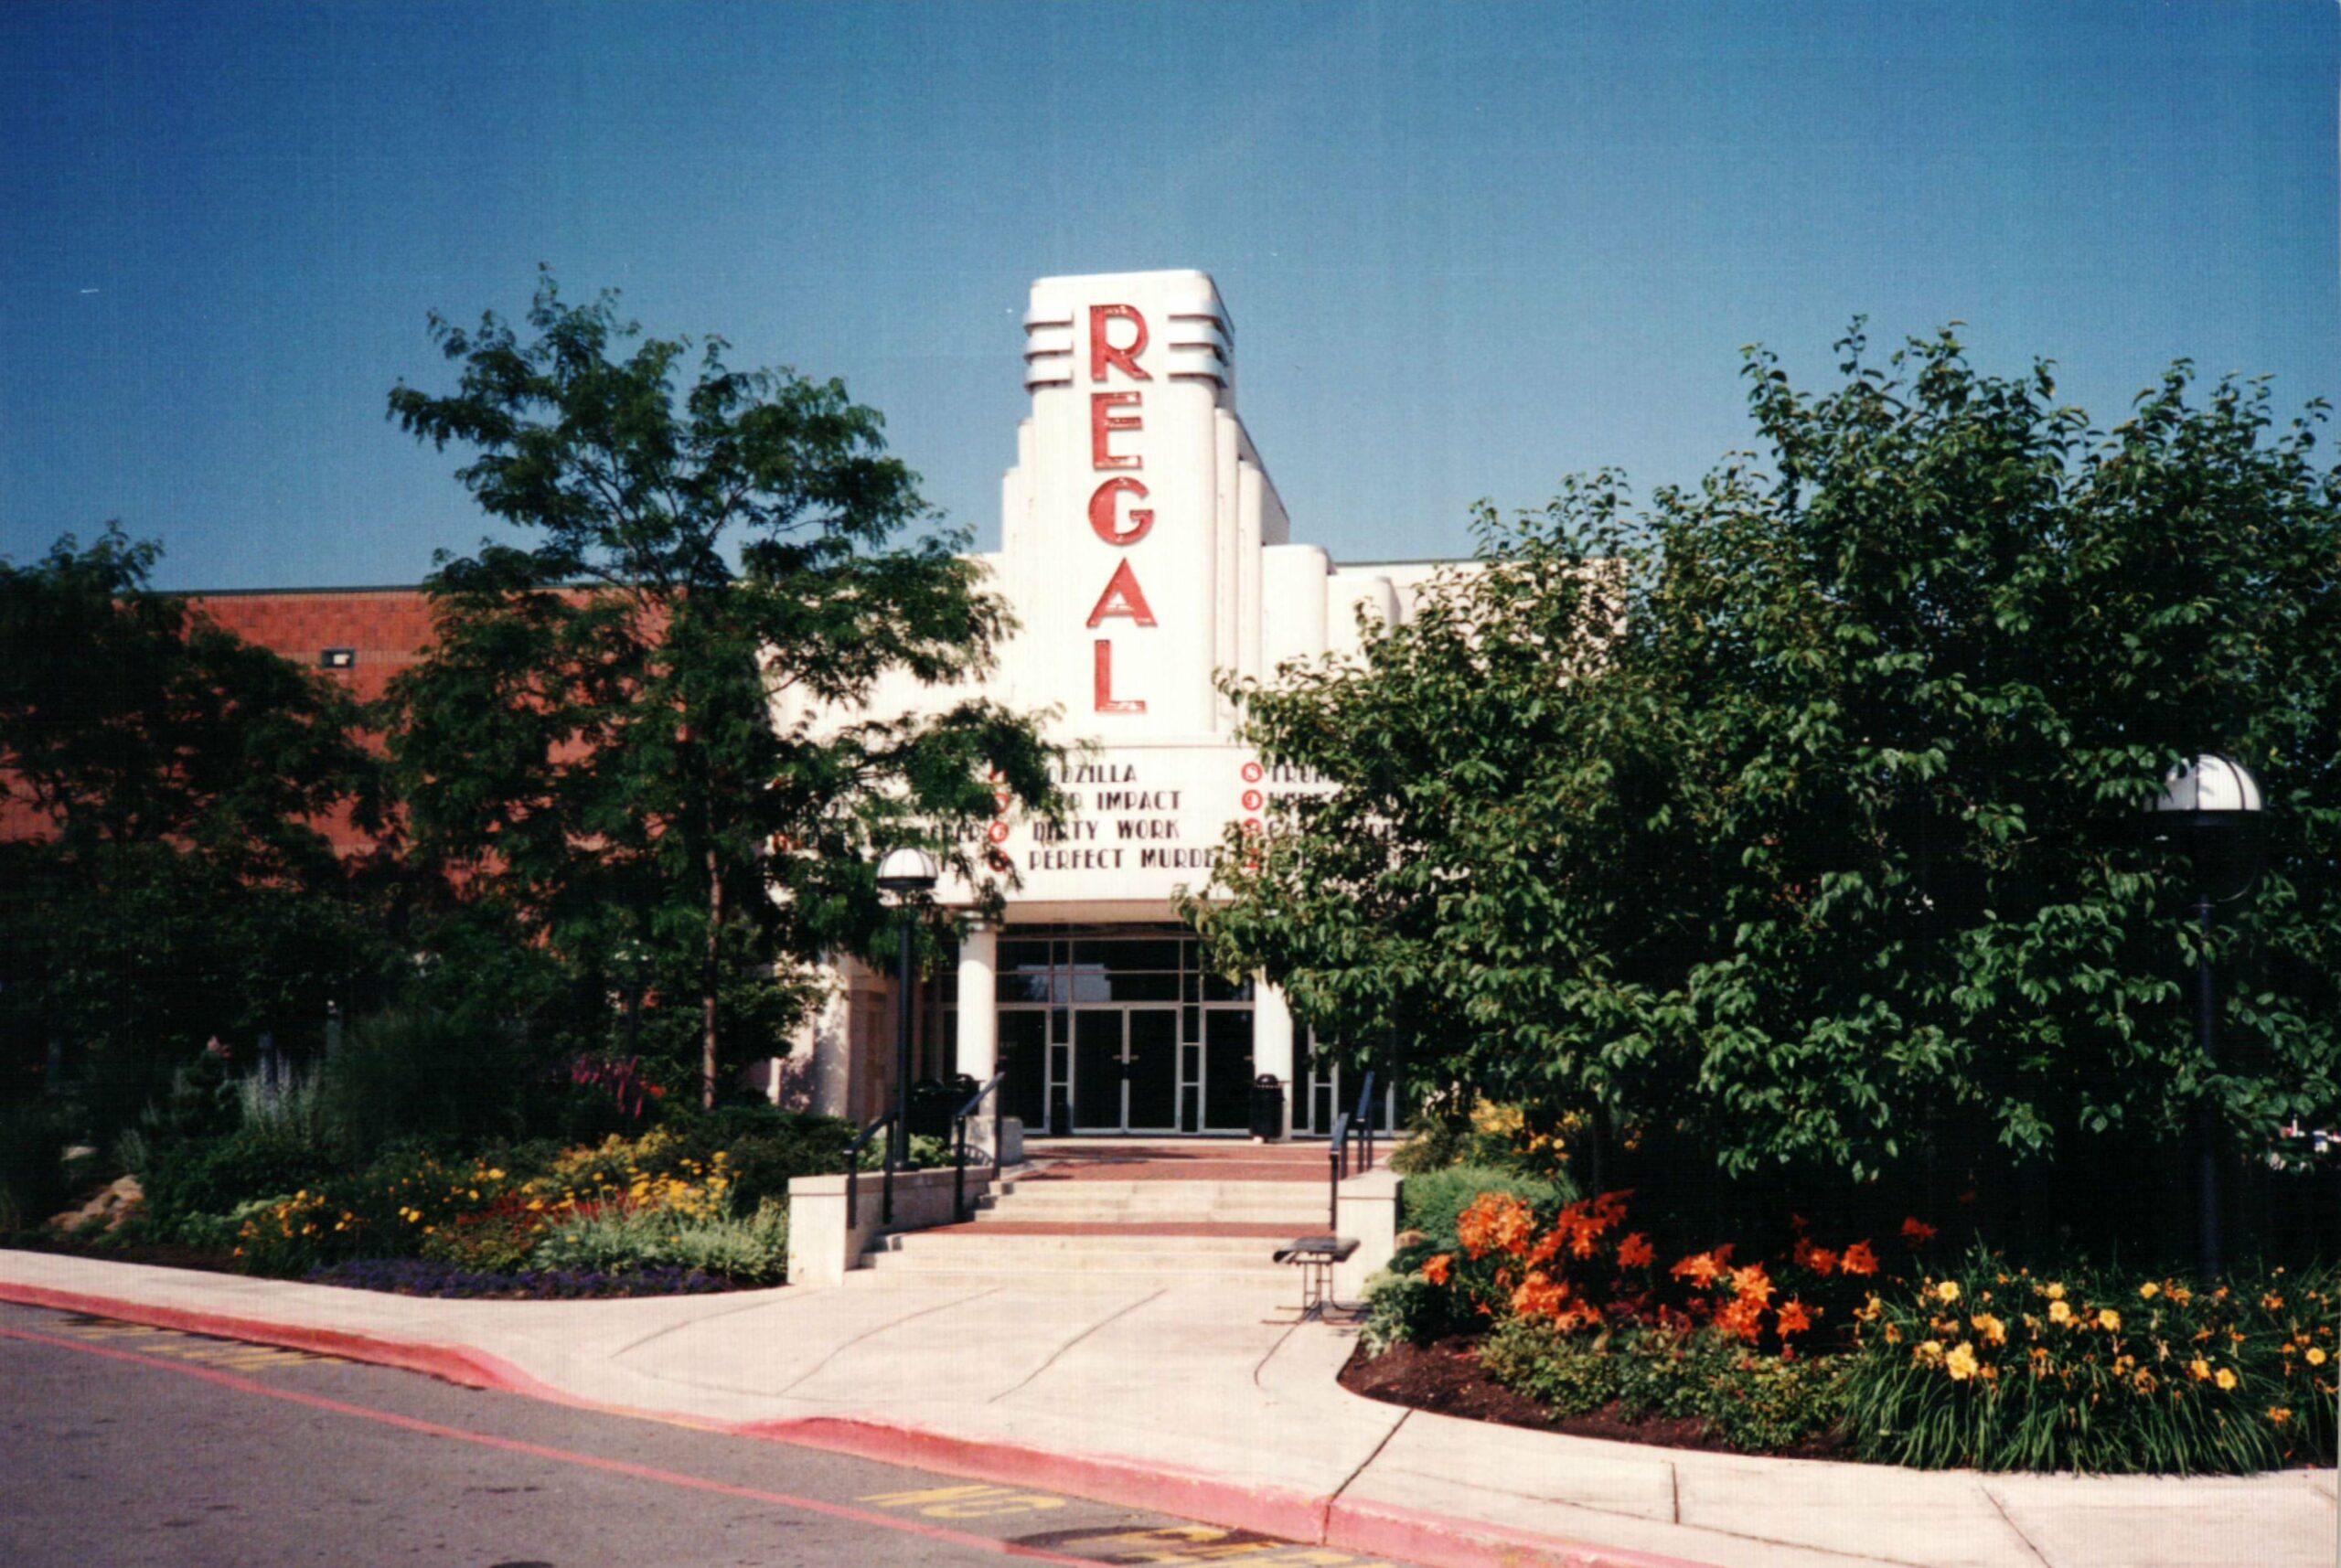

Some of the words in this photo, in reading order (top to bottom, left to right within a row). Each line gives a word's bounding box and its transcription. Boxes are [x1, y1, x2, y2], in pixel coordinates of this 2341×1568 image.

[1085, 304, 1158, 716] REGAL
[1044, 764, 1137, 784] ODZILLA
[1096, 790, 1181, 811] IMPACT
[1032, 820, 1098, 840] DITY
[1117, 819, 1180, 839] WORK
[1029, 848, 1124, 870] PERFECT
